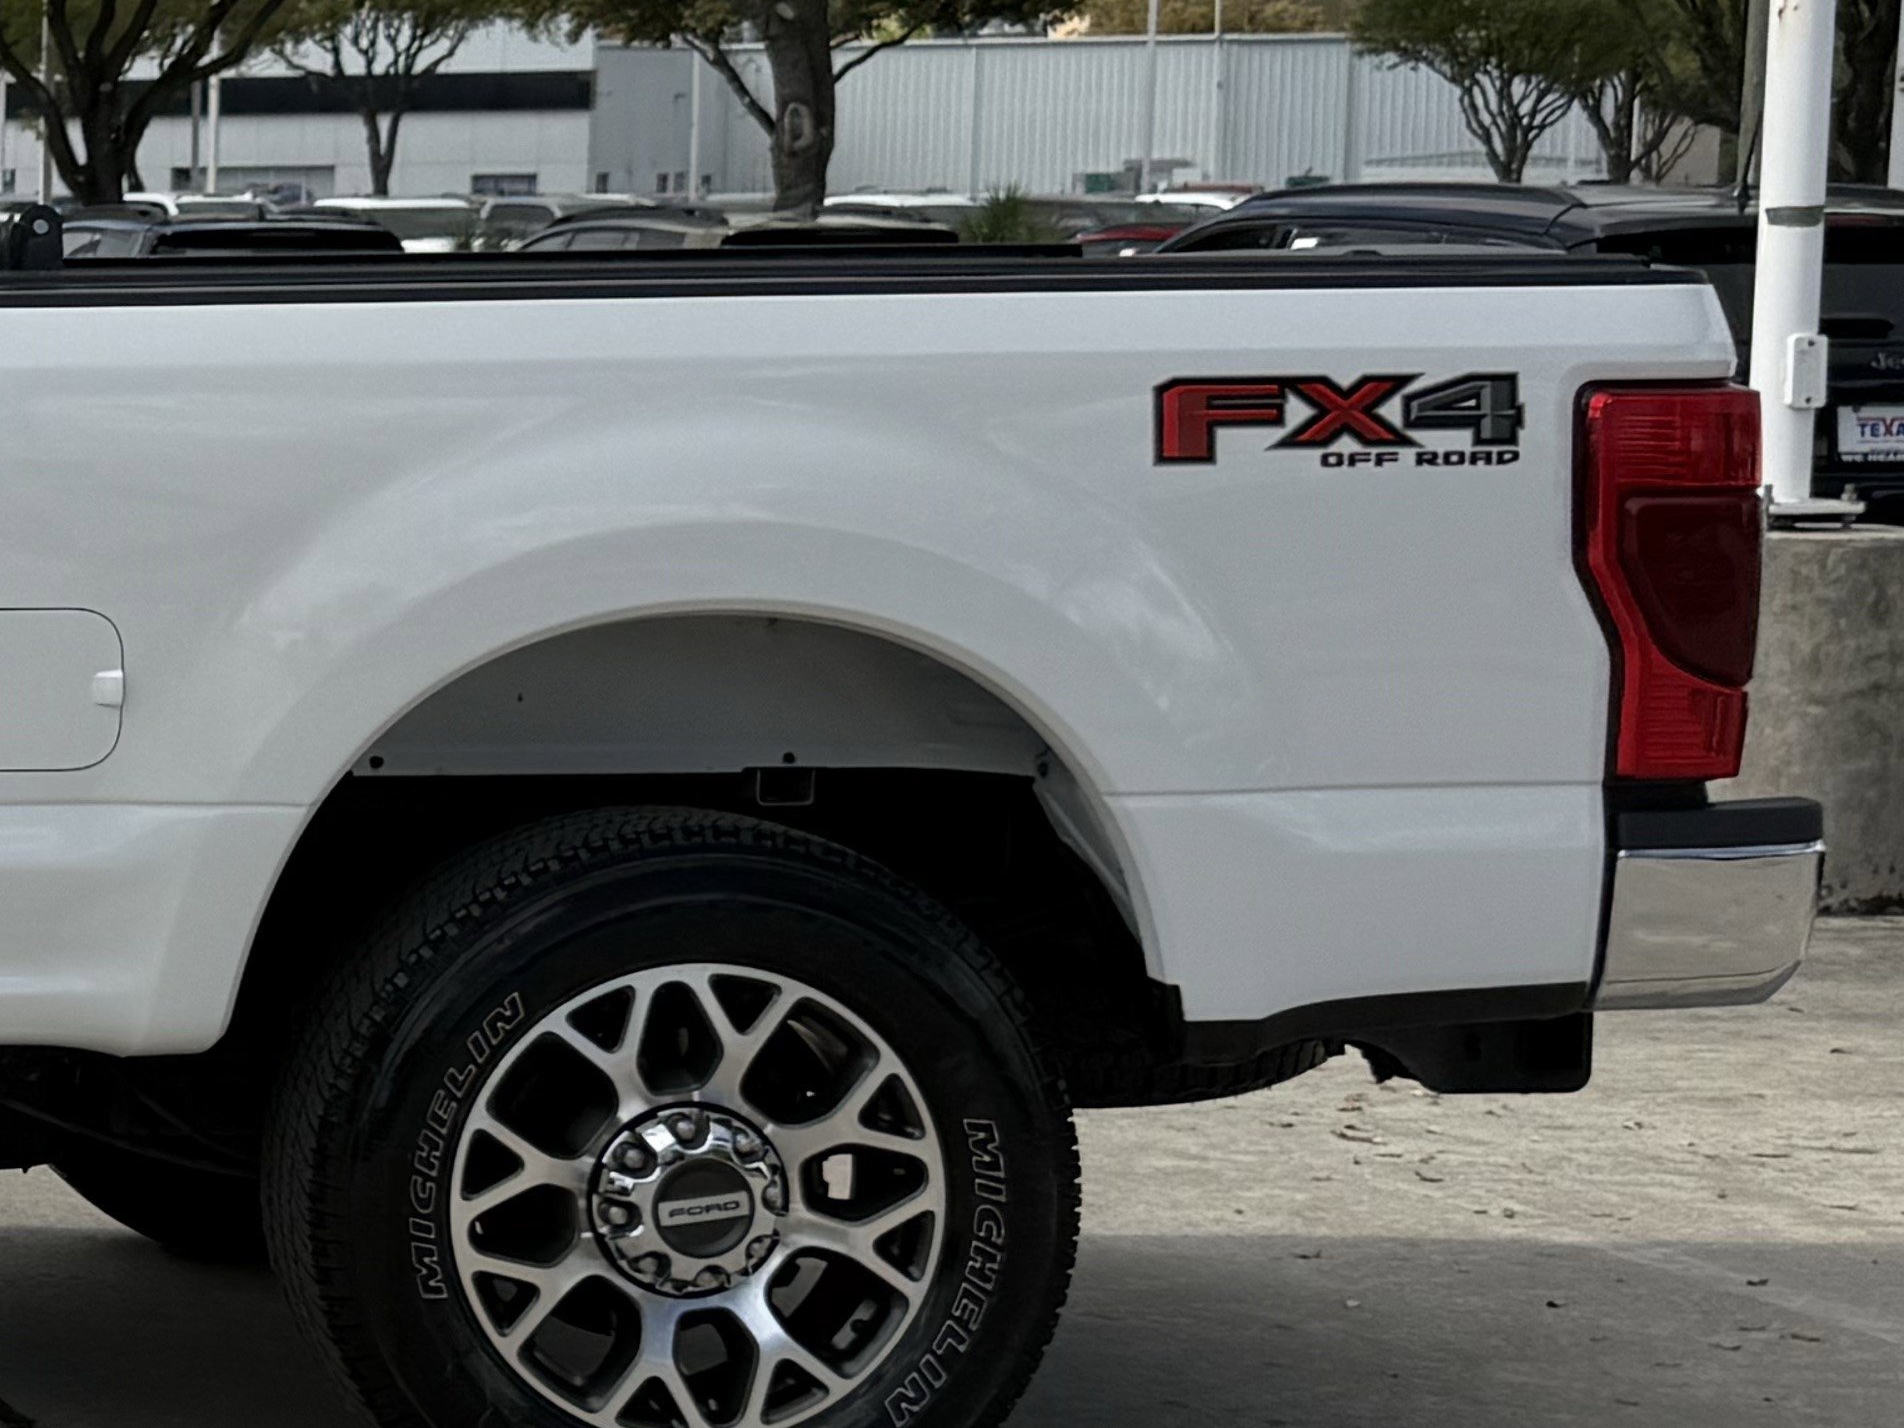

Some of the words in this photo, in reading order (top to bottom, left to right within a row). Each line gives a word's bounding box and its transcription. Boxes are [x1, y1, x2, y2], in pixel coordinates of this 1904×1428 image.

[1153, 372, 1525, 466] FX4
[1320, 450, 1400, 468] OFF
[1414, 449, 1521, 467] ROAD
[408, 991, 525, 1300] MICHELIN
[668, 1199, 741, 1219] FORD
